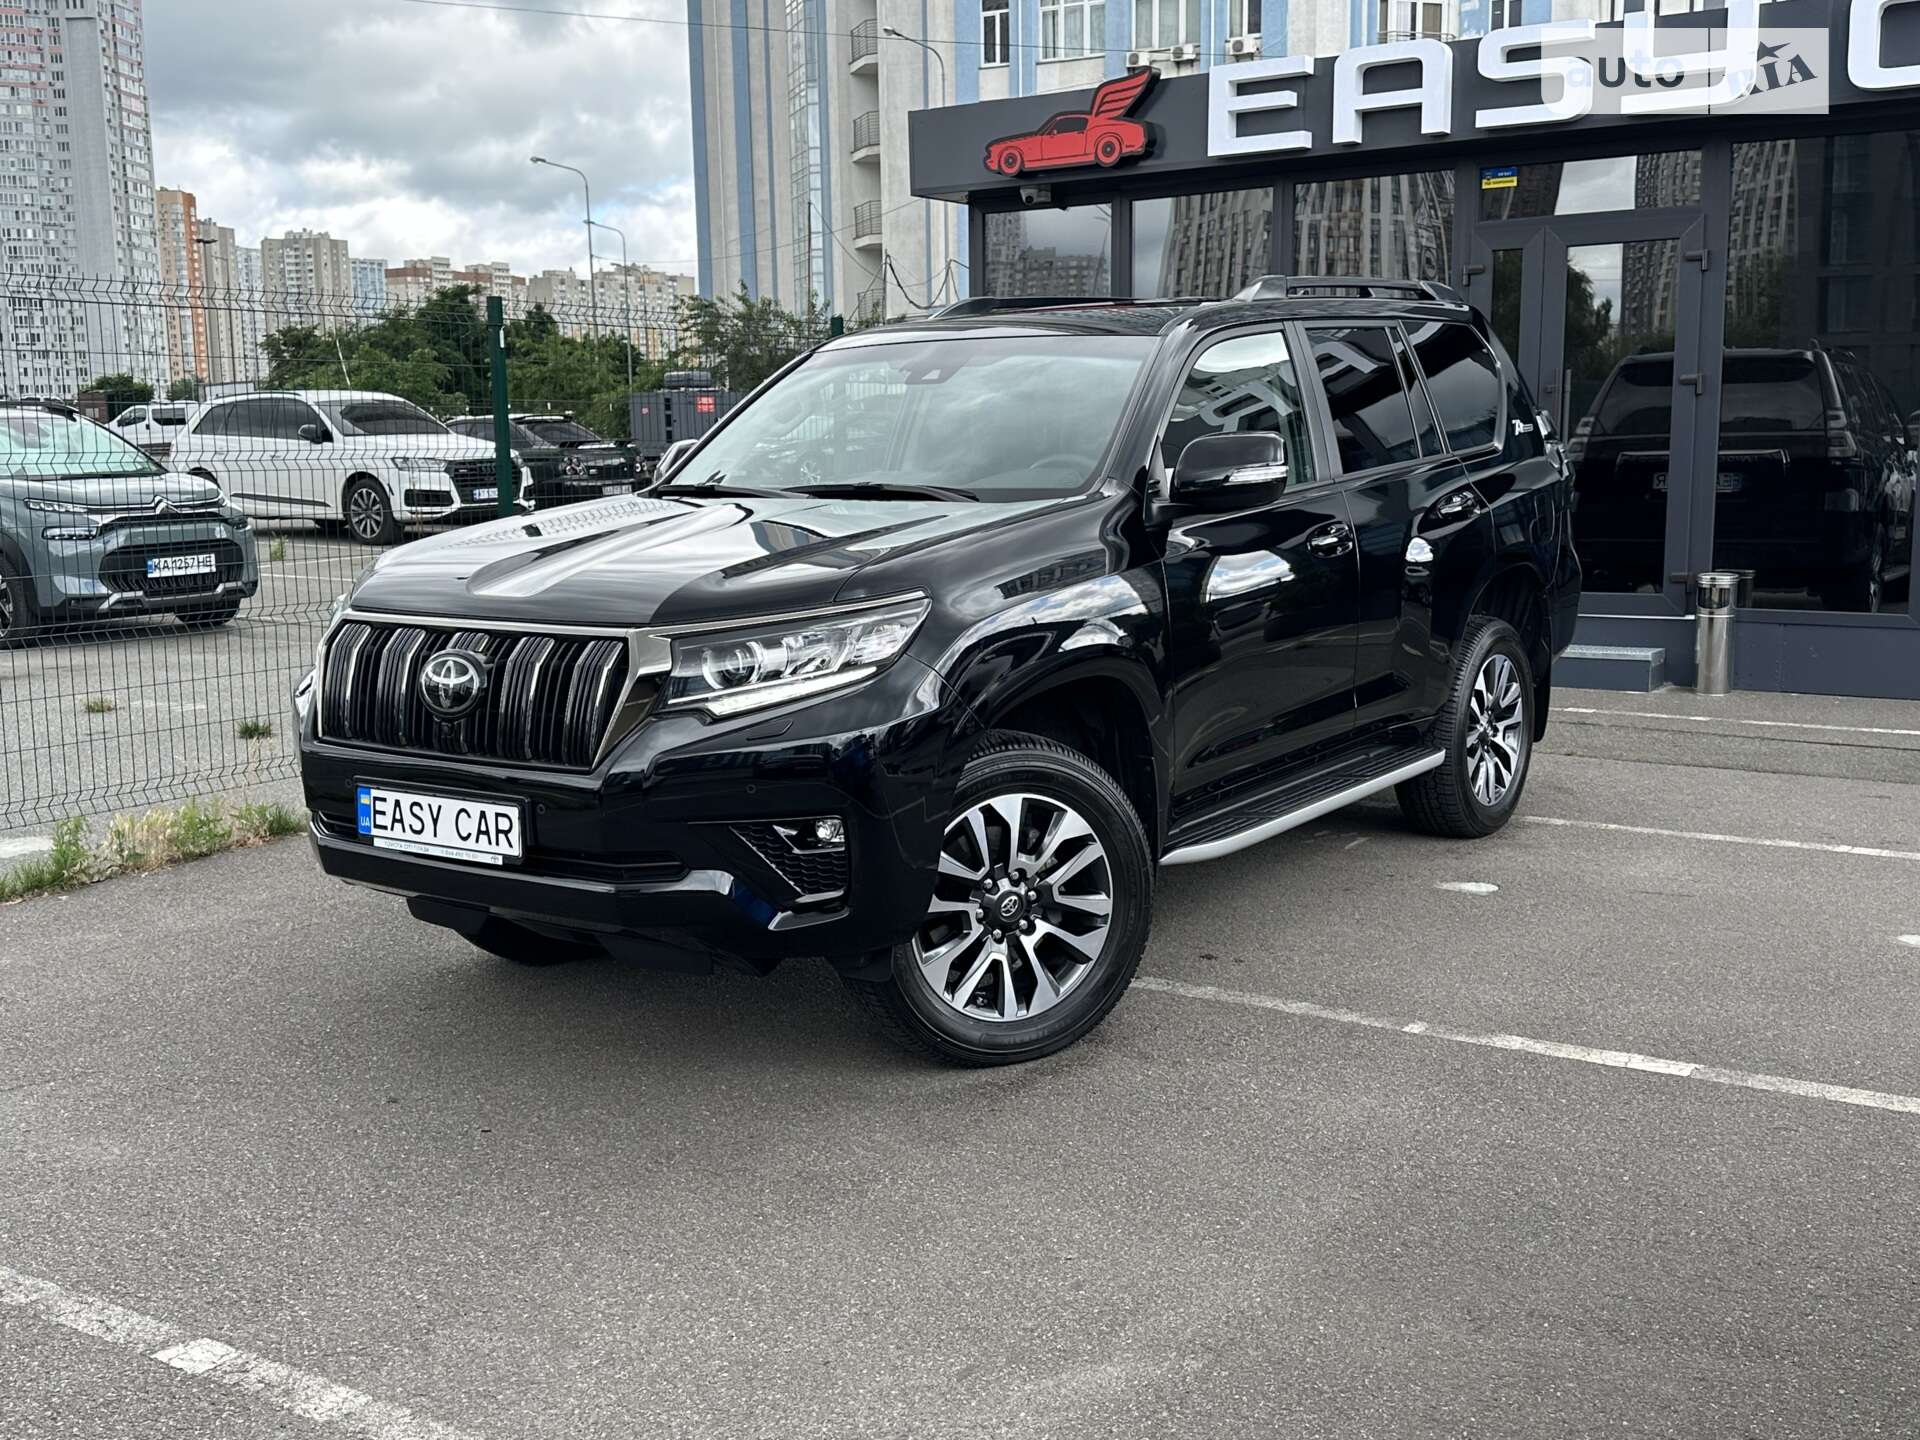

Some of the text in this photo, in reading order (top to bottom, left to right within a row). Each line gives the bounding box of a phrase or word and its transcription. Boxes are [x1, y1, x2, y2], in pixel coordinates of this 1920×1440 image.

[1208, 0, 1760, 157] EASY
[360, 816, 370, 827] UA
[372, 796, 514, 849] EASY CAR
